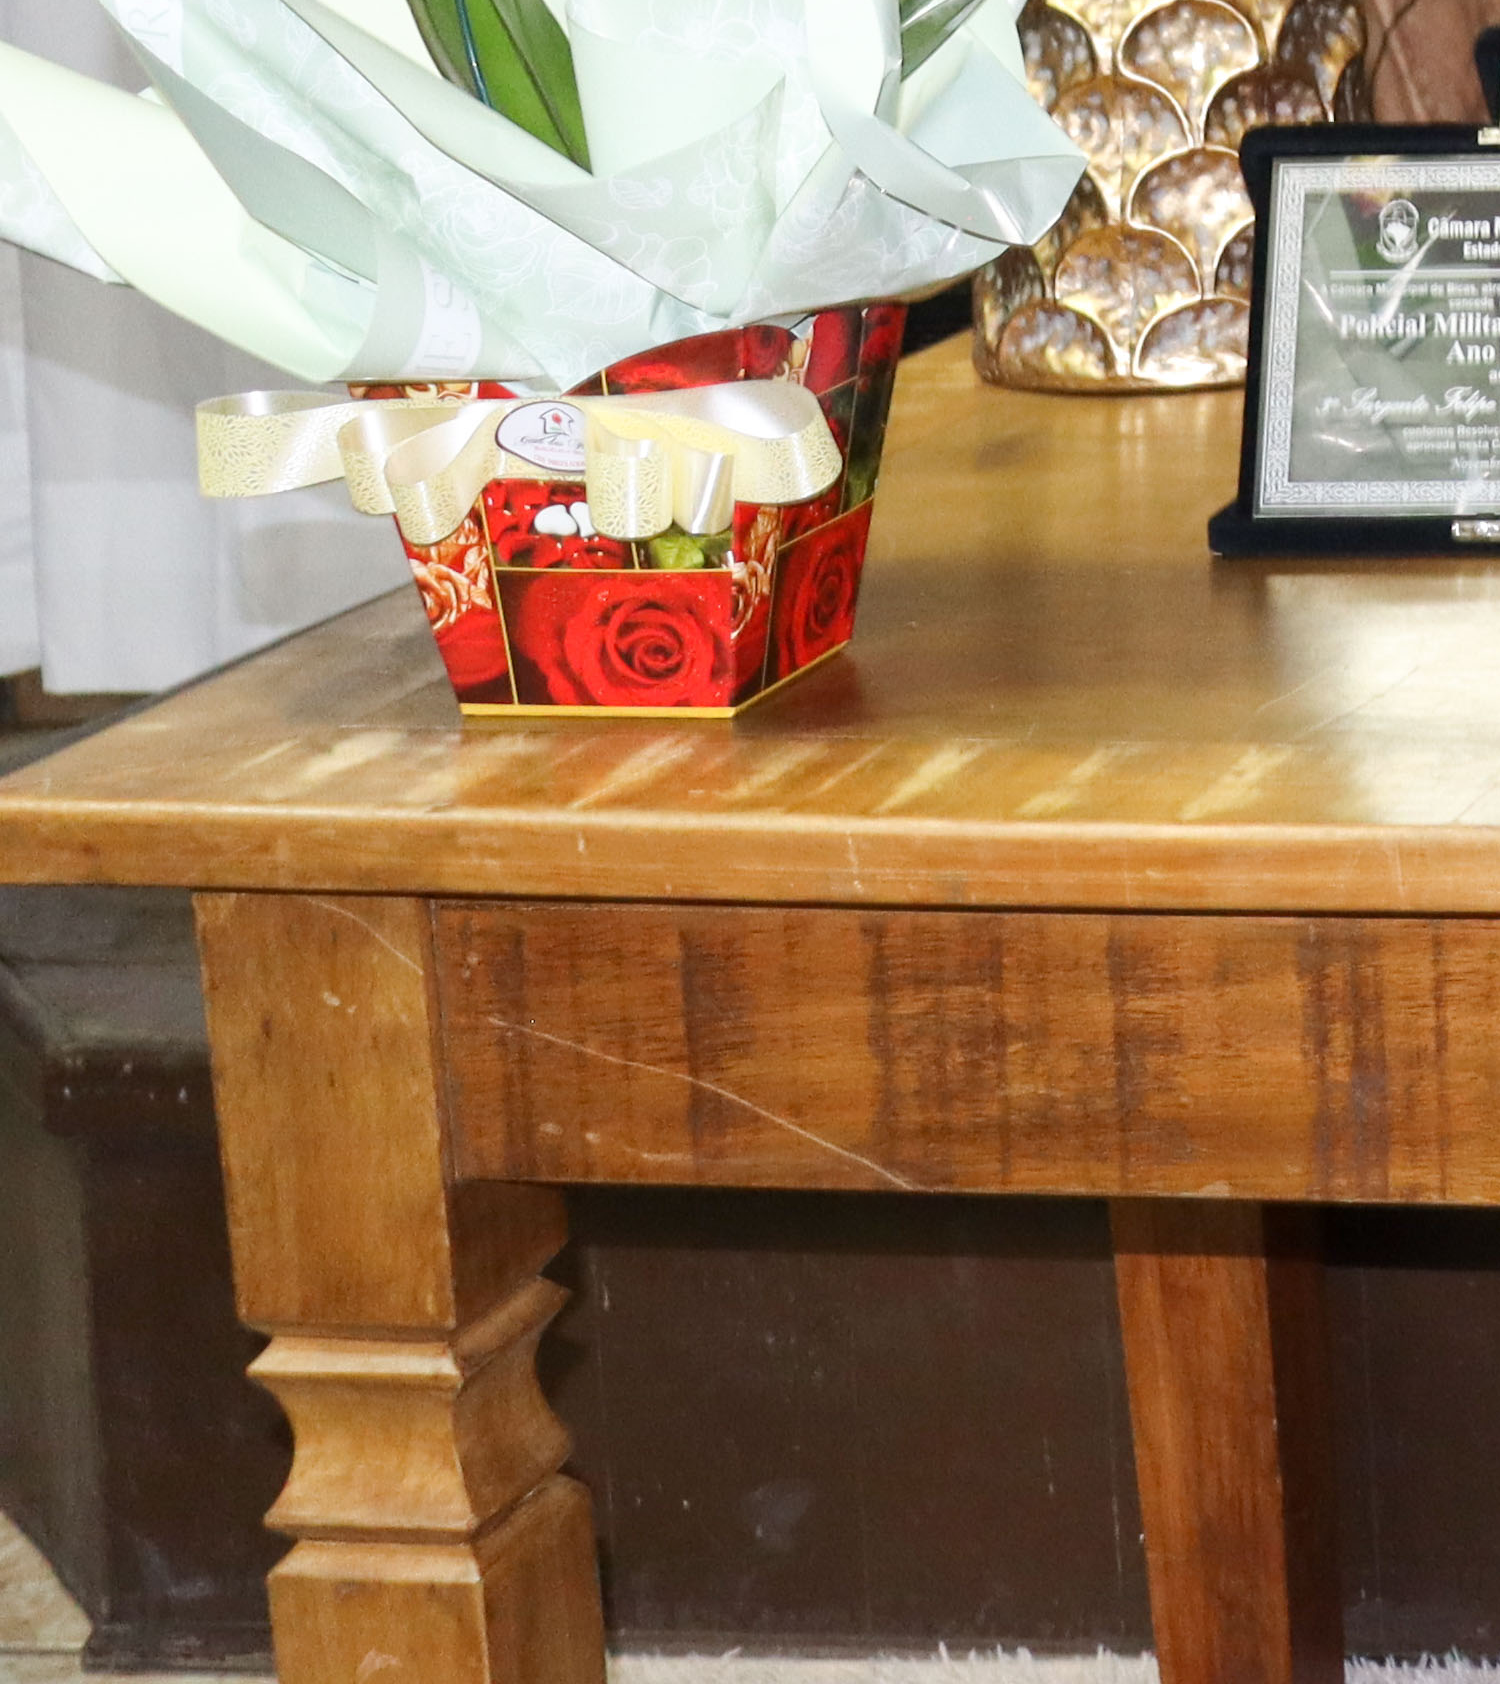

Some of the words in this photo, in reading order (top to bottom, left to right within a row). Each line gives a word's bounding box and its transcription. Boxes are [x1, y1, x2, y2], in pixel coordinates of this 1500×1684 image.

[1428, 216, 1490, 237] Câmara
[1340, 312, 1426, 336] Policial
[1447, 341, 1495, 363] Ano
